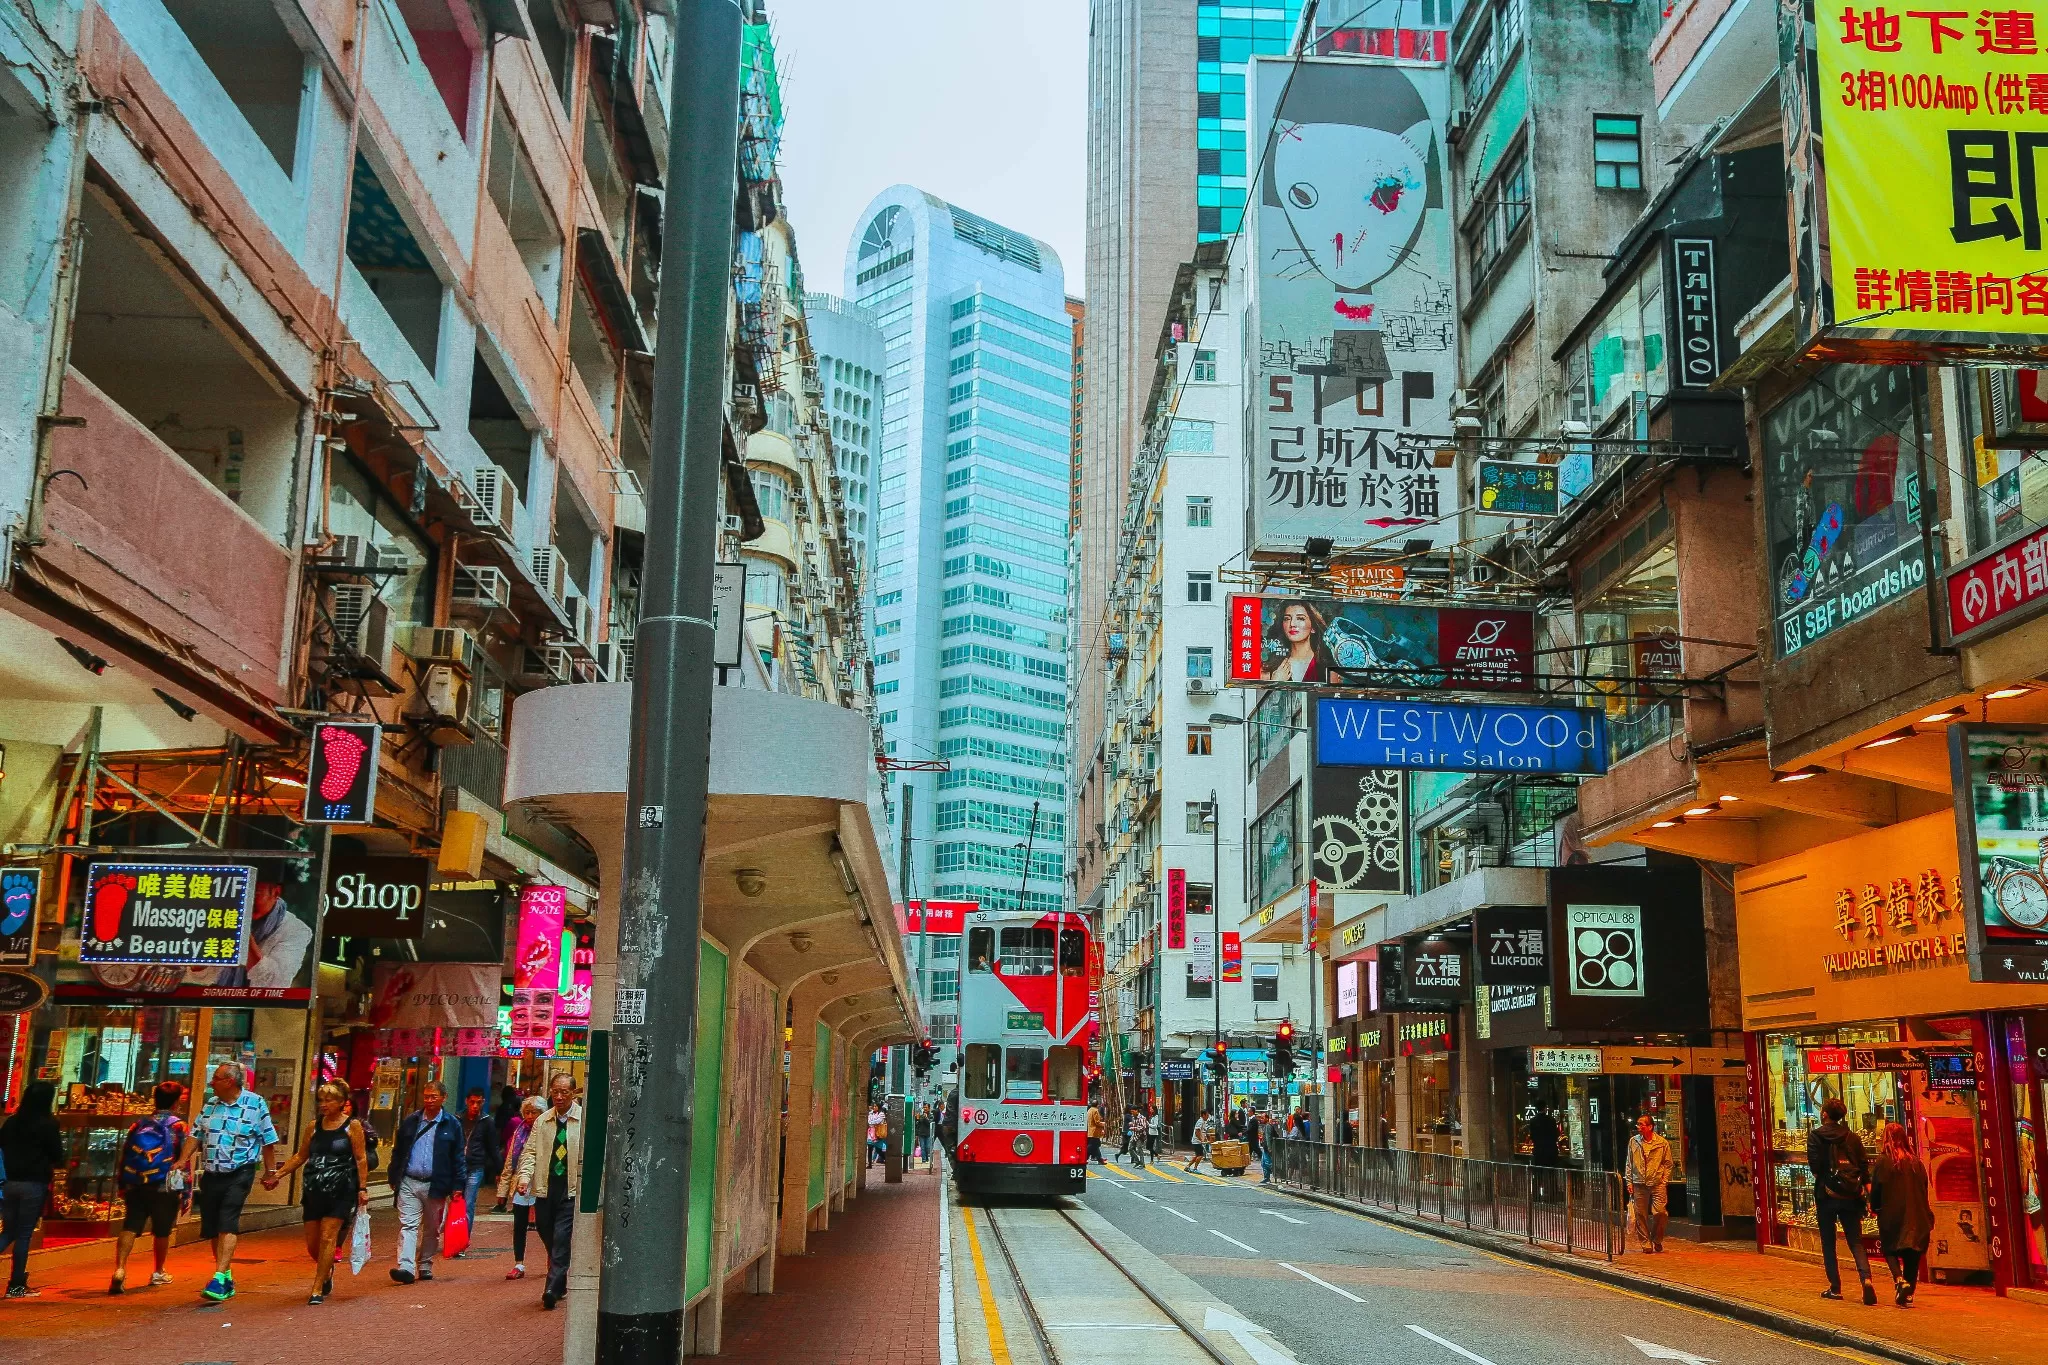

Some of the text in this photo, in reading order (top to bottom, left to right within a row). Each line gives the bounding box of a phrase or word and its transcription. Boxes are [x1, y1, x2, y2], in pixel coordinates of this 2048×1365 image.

[1839, 5, 2048, 55] 地下連
[1853, 267, 2048, 316] 詳情請向各
[1684, 249, 1712, 375] TATTOO
[1268, 363, 1435, 427] STOP
[1268, 425, 1432, 472] 己所不欲
[1266, 466, 1441, 518] 勿施於貓
[1805, 555, 1936, 639] SBF boardsho
[1488, 661, 1509, 669] MADE
[1385, 746, 1542, 768] Hair Salon
[322, 804, 352, 820] 1/F
[332, 873, 422, 920] Shop
[520, 890, 561, 903] DECO
[132, 900, 240, 934] Massage 保健
[976, 913, 988, 922] 92
[1573, 911, 1635, 924] OPTICAL 88
[129, 934, 204, 959] Beauty
[203, 938, 236, 959] 美容
[1490, 928, 1544, 955] 六福
[1822, 932, 1967, 973] VALUABLE WATCH & JE
[1415, 953, 1461, 977] 六福
[1490, 955, 1544, 967] LUKFOOK
[202, 988, 285, 998] SIGNATURE OF TIME
[1415, 977, 1461, 987] LUKFOOK
[1813, 1053, 1839, 1063] WEST
[1825, 1064, 1841, 1072] Hair
[1748, 1086, 1760, 1201] CHARRIOL
[1978, 1080, 1998, 1228] CHARRIOL
[1070, 1168, 1084, 1178] 92
